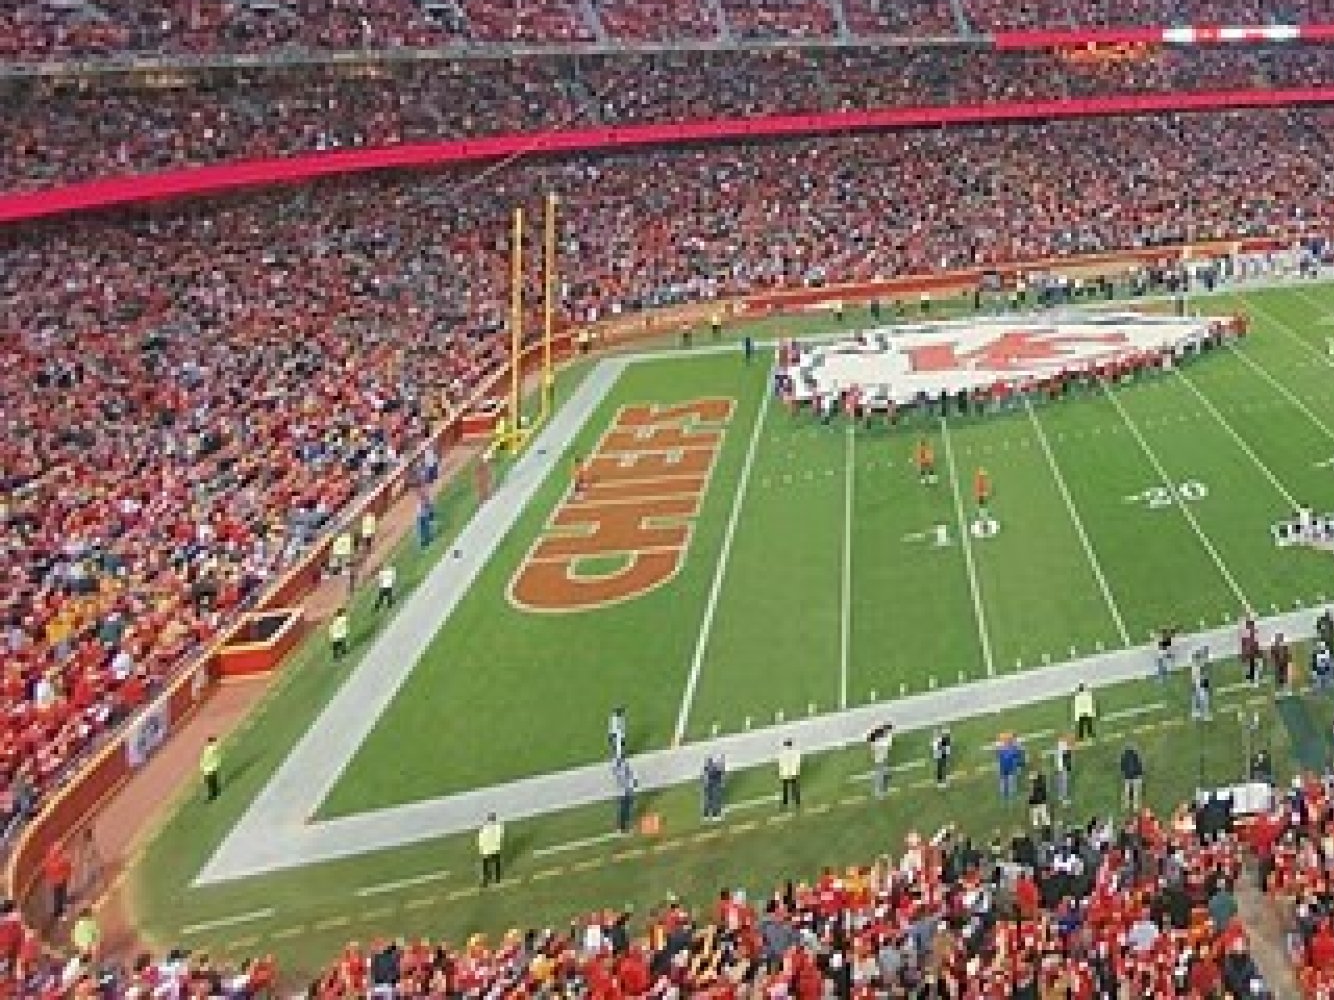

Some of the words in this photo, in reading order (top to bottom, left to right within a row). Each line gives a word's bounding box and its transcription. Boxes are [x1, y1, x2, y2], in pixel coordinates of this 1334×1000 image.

[504, 396, 738, 613] CHIEFS
[1142, 483, 1208, 508] 20
[933, 520, 1000, 547] 10
